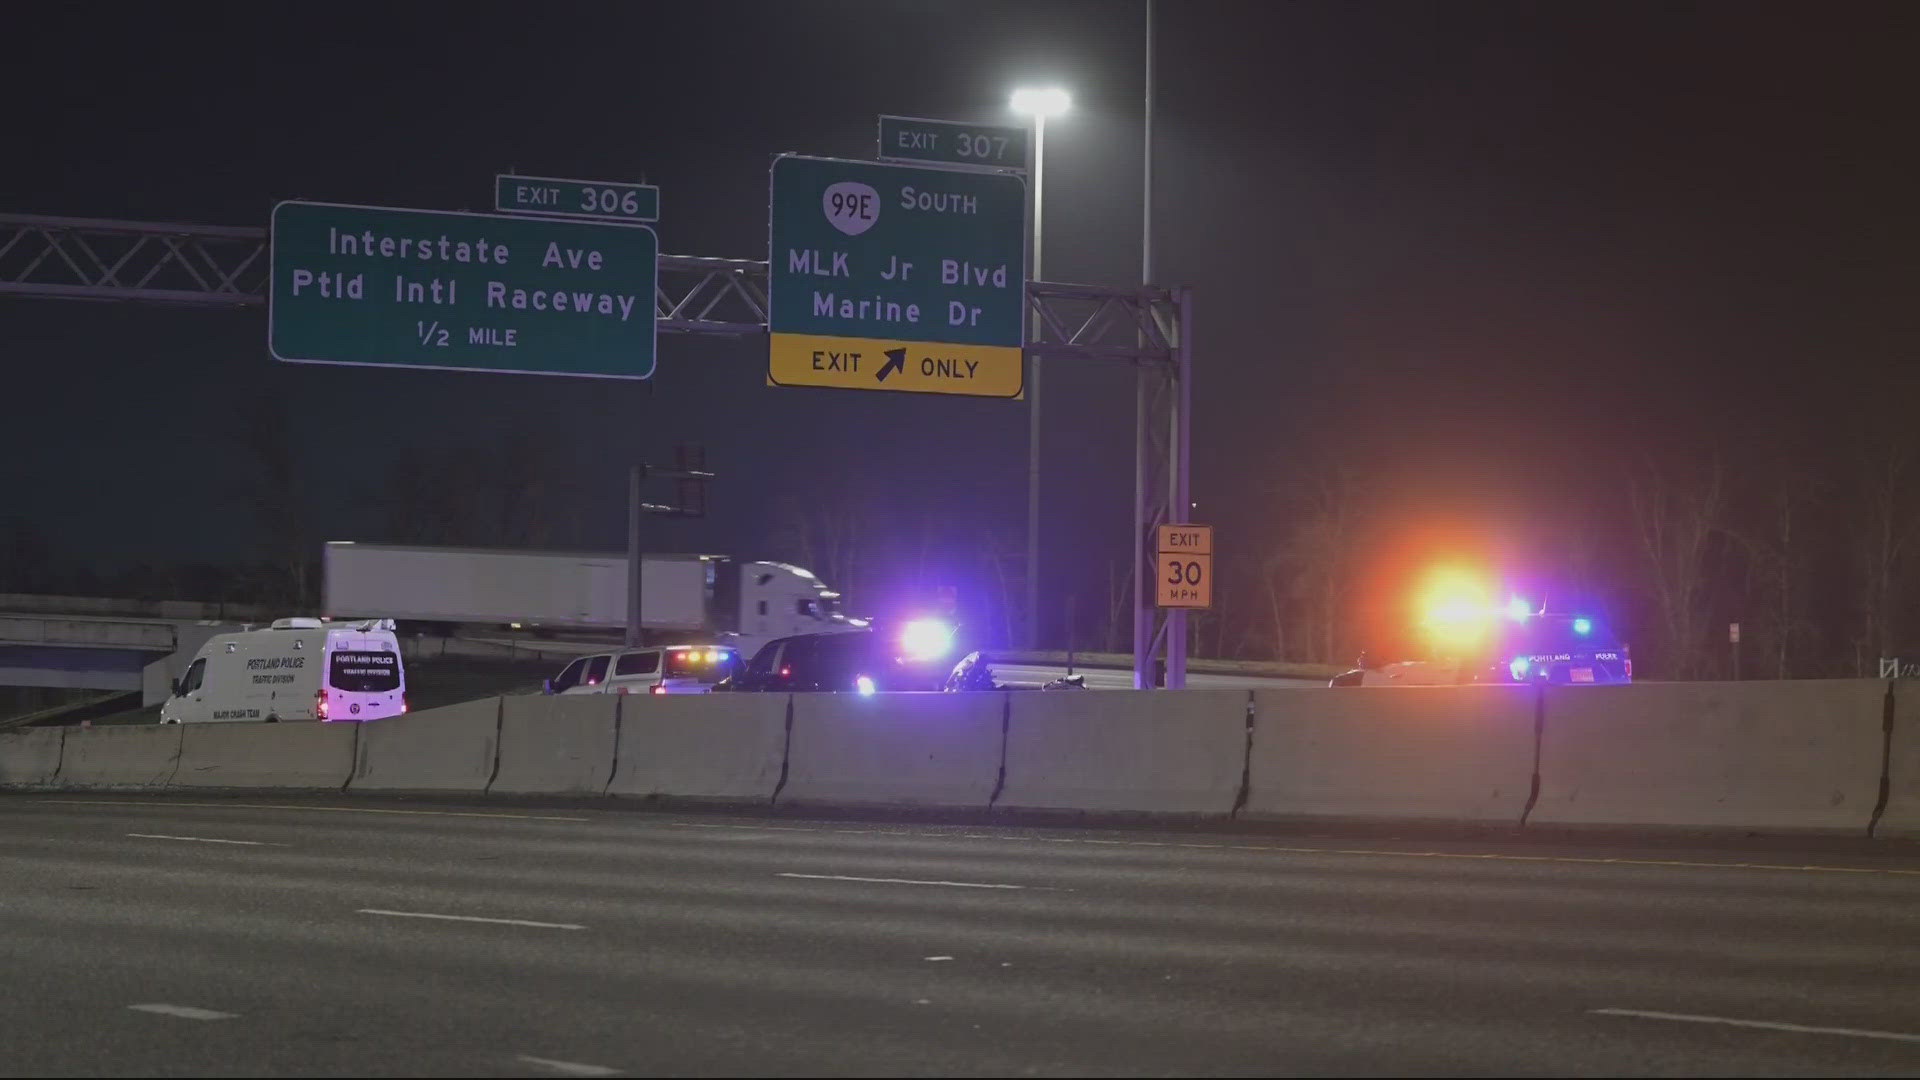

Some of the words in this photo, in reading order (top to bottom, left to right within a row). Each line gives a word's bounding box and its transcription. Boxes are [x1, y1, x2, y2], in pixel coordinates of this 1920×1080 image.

[898, 131, 939, 150] EXIT
[956, 133, 1010, 159] 307
[516, 186, 560, 205] EXIT
[580, 187, 639, 214] 306
[831, 193, 872, 220] 99E
[329, 227, 510, 264] Interstate
[542, 241, 603, 270] Ave
[788, 248, 850, 277] MLK
[880, 255, 913, 280] Jr
[941, 259, 1007, 288] Blvd
[292, 269, 363, 299] Ptld
[396, 275, 456, 305] Intl
[487, 281, 635, 321] Raceway
[813, 291, 920, 322] Marine
[948, 300, 982, 326] Dr
[468, 327, 517, 346] MILE
[812, 351, 862, 372] EXIT
[921, 357, 979, 379] ONLY
[1170, 532, 1200, 546] EXIT
[1167, 561, 1202, 586] 30
[1170, 589, 1198, 600] MPH
[247, 657, 280, 670] PORTLAND
[281, 656, 305, 668] POLICE
[336, 655, 371, 664] PORTLAND
[372, 656, 394, 665] POLICE
[252, 674, 272, 685] TRAFFIC
[272, 673, 295, 684] DIVISION
[213, 710, 229, 719] MAJOR
[247, 708, 260, 718] TEAM
